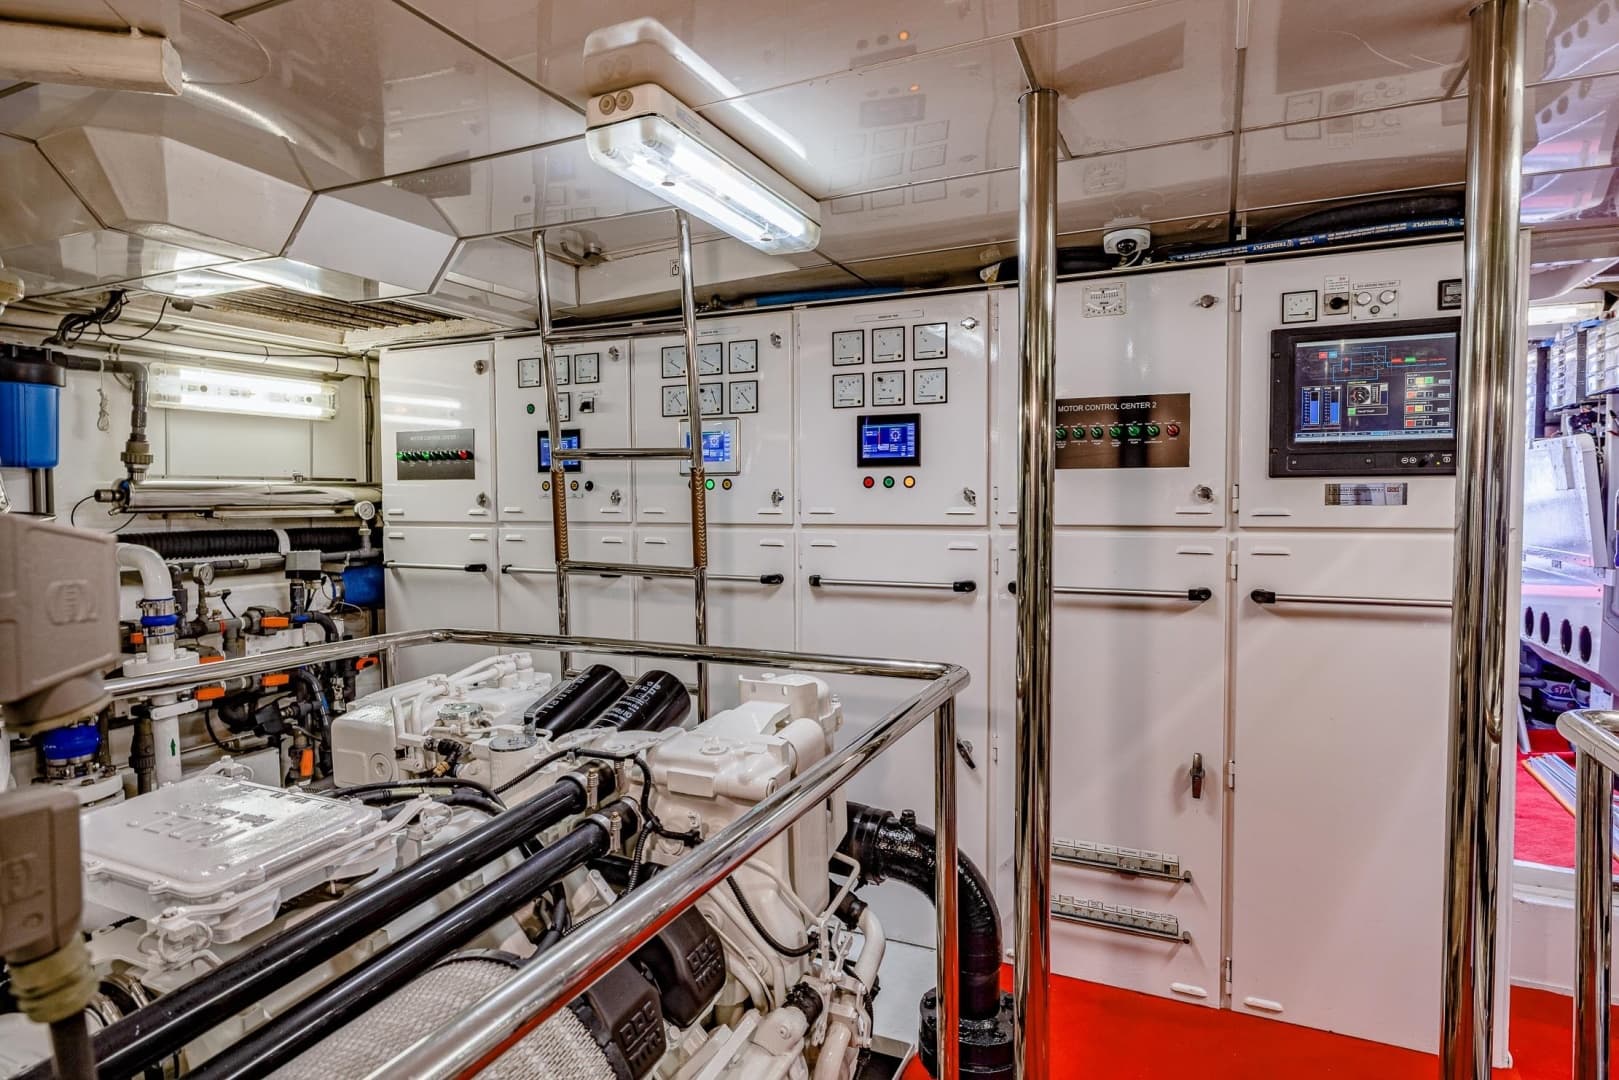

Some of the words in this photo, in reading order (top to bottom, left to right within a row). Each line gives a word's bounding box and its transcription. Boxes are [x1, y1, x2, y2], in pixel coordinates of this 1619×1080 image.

[1058, 404, 1084, 413] MOTOR
[1085, 402, 1120, 412] CONTROL
[1120, 401, 1151, 410] CENTER
[1151, 401, 1157, 409] 2
